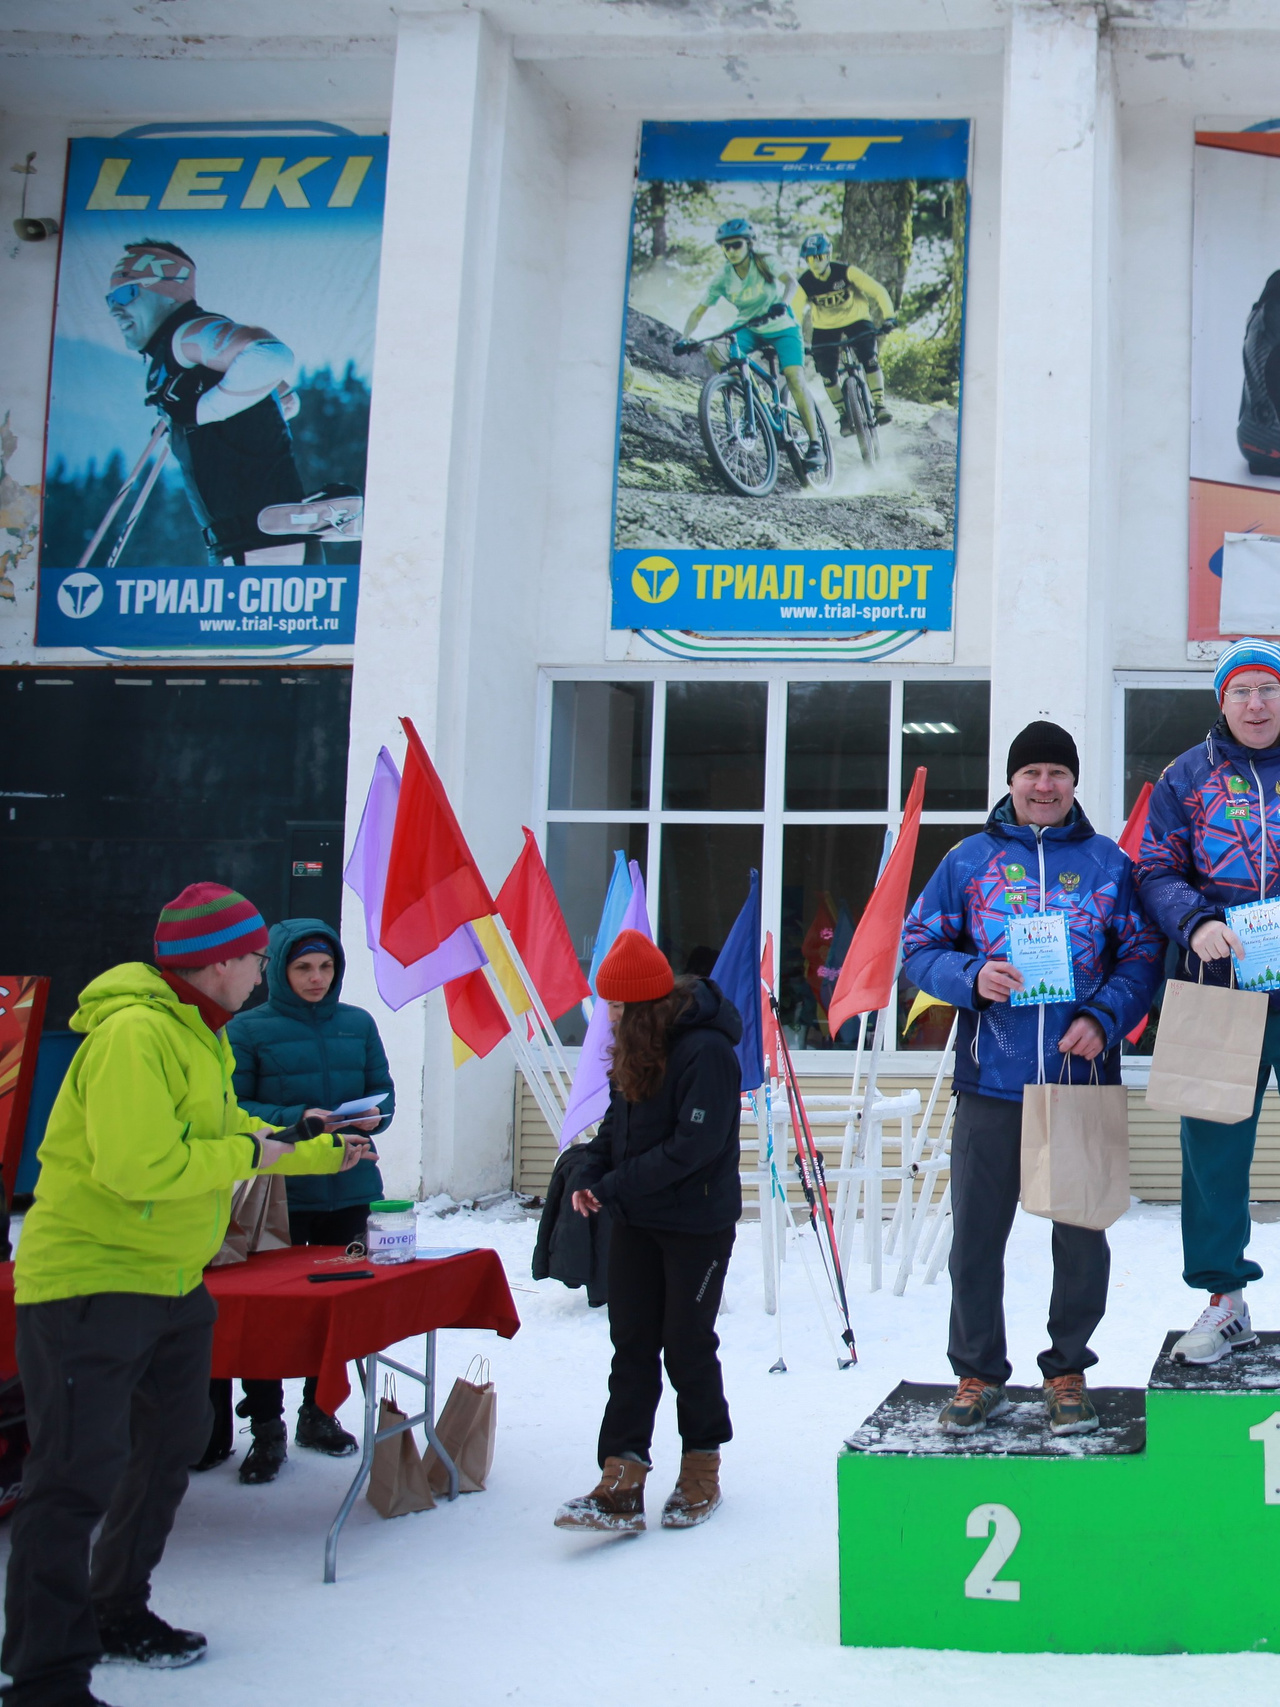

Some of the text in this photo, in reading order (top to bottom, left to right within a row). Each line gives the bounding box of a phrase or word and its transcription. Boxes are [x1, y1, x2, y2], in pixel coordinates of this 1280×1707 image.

[720, 136, 903, 162] GT
[782, 163, 857, 171] BICYCLES
[85, 155, 374, 210] LEKI
[780, 603, 926, 621] www.trial-sport.ru
[200, 616, 339, 634] www.trial-sport.ru
[1239, 922, 1280, 936] ГРАМОТА
[1018, 935, 1059, 946] ГРАМОТА
[964, 1503, 1021, 1602] 2
